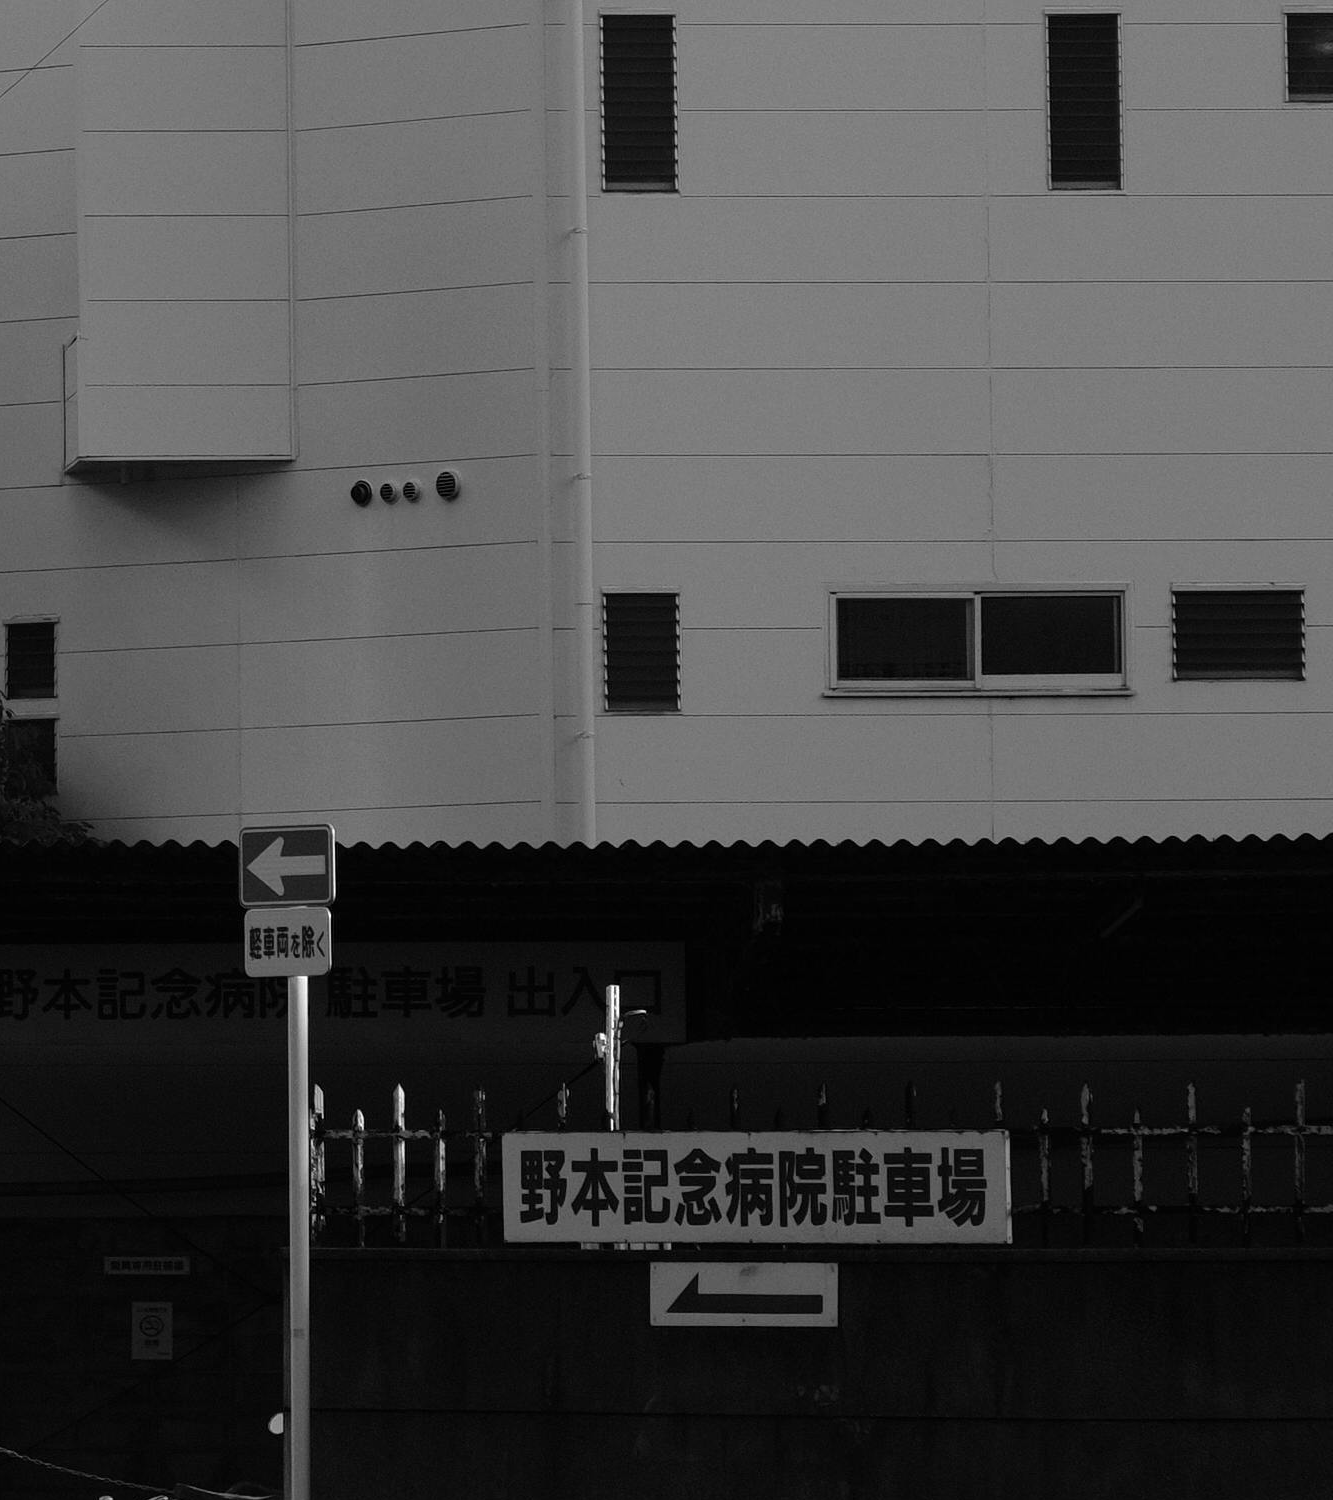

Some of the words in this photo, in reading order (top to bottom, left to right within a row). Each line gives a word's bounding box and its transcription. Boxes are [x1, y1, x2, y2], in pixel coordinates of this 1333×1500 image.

[249, 925, 326, 960] 軽車両を除く
[323, 965, 485, 1020] 駐車場
[506, 965, 663, 1019] 出入口
[519, 1147, 987, 1227] 野本記念病院駐車場
